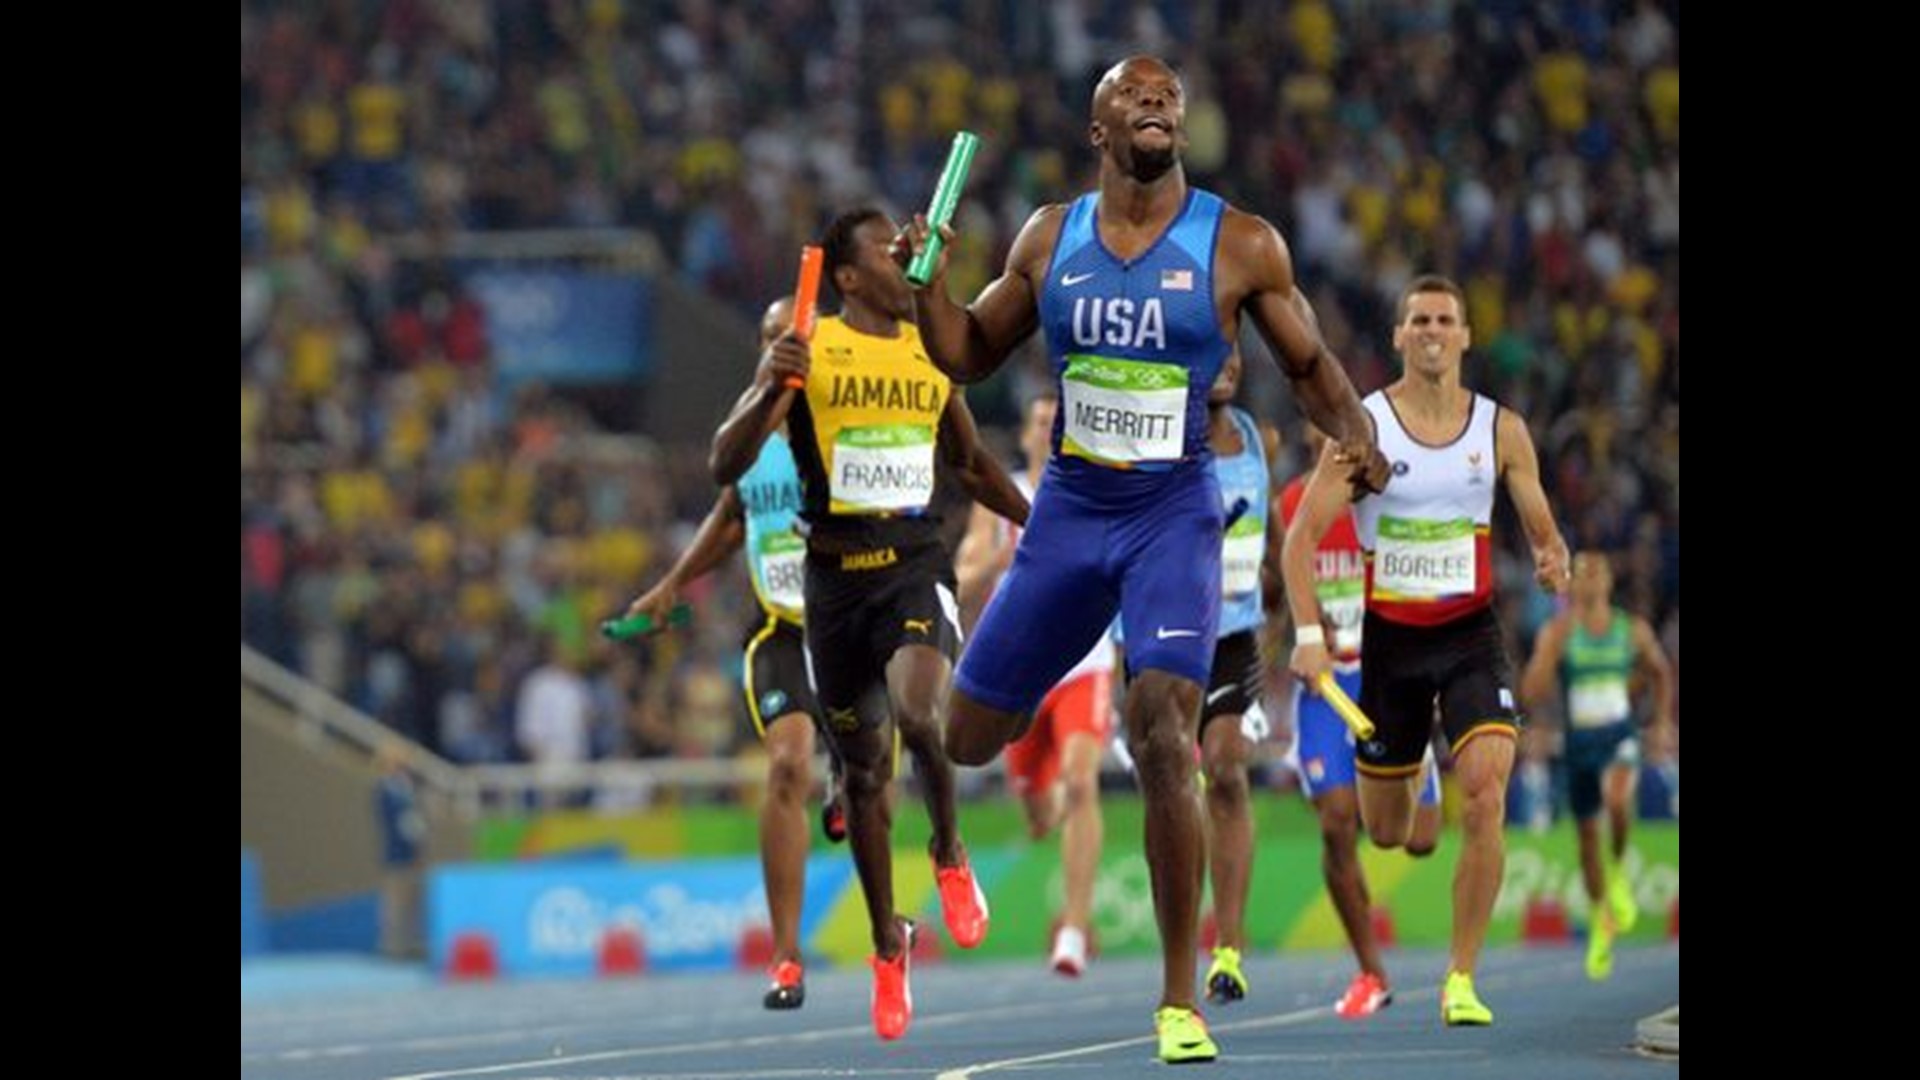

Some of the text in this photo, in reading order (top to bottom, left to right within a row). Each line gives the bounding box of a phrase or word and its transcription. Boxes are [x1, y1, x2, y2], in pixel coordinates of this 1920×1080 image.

[1073, 297, 1166, 349] USA
[829, 373, 942, 415] JAMAICA
[1075, 401, 1175, 440] MERRITT
[842, 463, 931, 490] FRANCIS
[841, 547, 898, 570] JAMAICA
[1383, 552, 1470, 580] BORLEE
